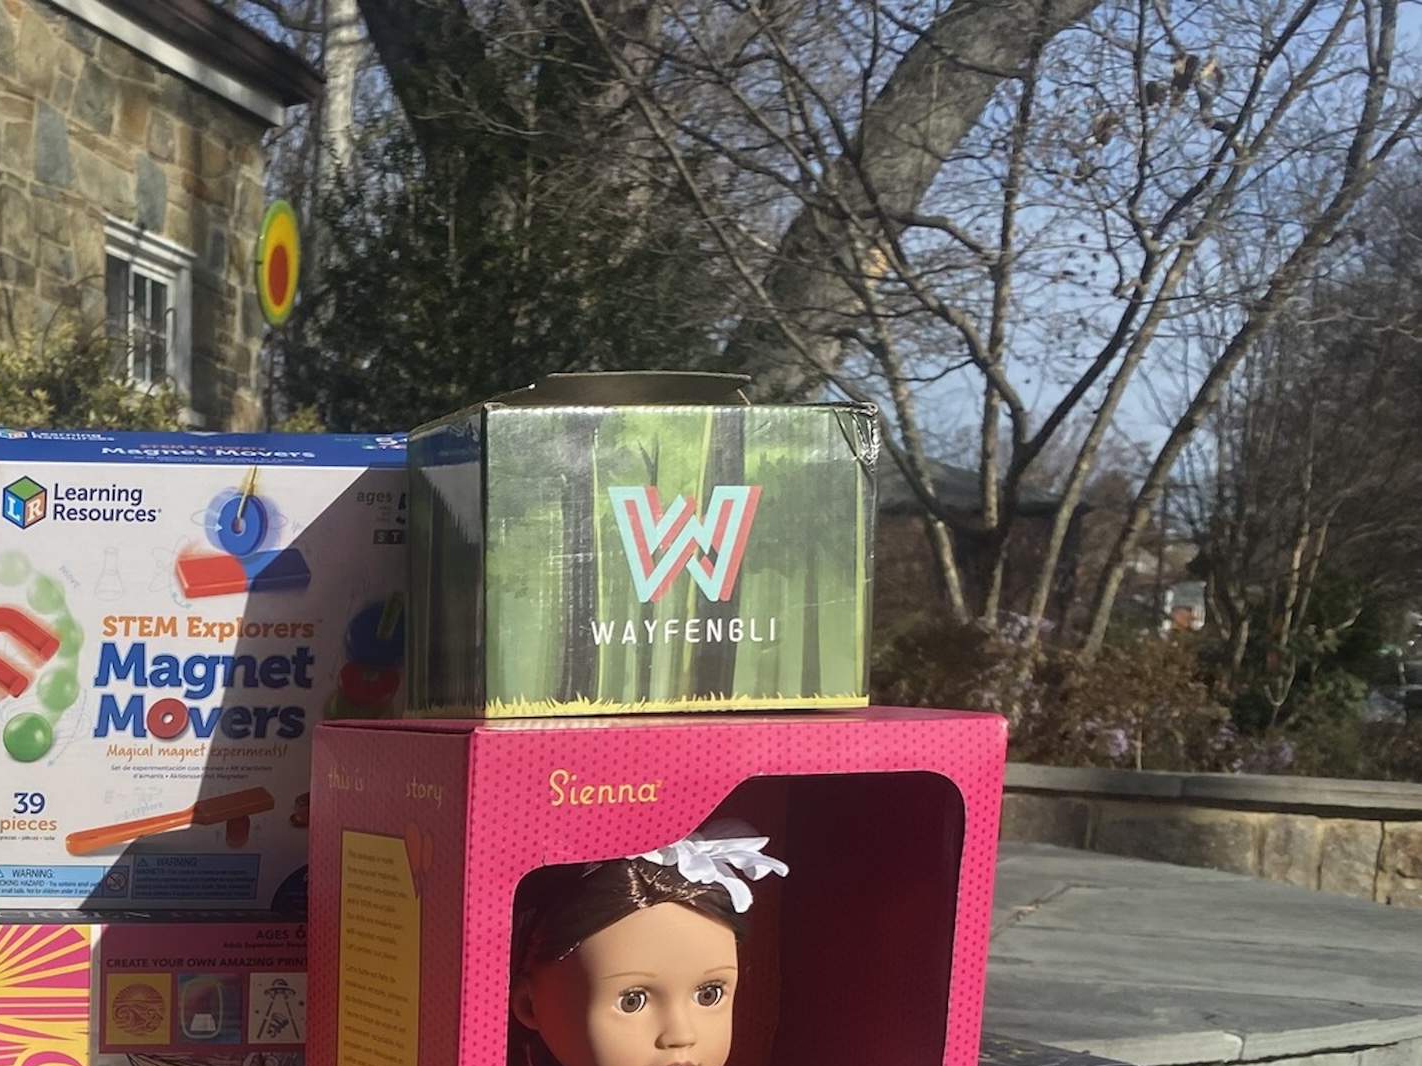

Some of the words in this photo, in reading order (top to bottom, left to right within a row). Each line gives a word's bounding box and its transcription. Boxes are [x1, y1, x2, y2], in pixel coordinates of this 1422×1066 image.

[101, 447, 208, 458] Magnet
[216, 448, 316, 459] Movers
[54, 483, 143, 506] Learning
[53, 503, 157, 522] Resources
[103, 616, 178, 637] STEM
[187, 616, 315, 643] Explorers
[590, 616, 777, 646] WAYFENGLI
[93, 642, 316, 700] Magnet
[93, 694, 306, 741] Movers
[106, 744, 153, 762] Magical
[158, 744, 205, 762] magnet
[210, 744, 288, 762] experiments!
[405, 775, 444, 808] story
[549, 768, 658, 807] Sienna
[13, 792, 46, 814] 39
[0, 817, 57, 833] pieces
[12, 868, 55, 879] WARNING:
[255, 929, 289, 940] AGES
[106, 959, 151, 968] CREATE
[152, 958, 183, 968] YOUR
[186, 958, 216, 967] OWN
[219, 958, 274, 967] AMAZING
